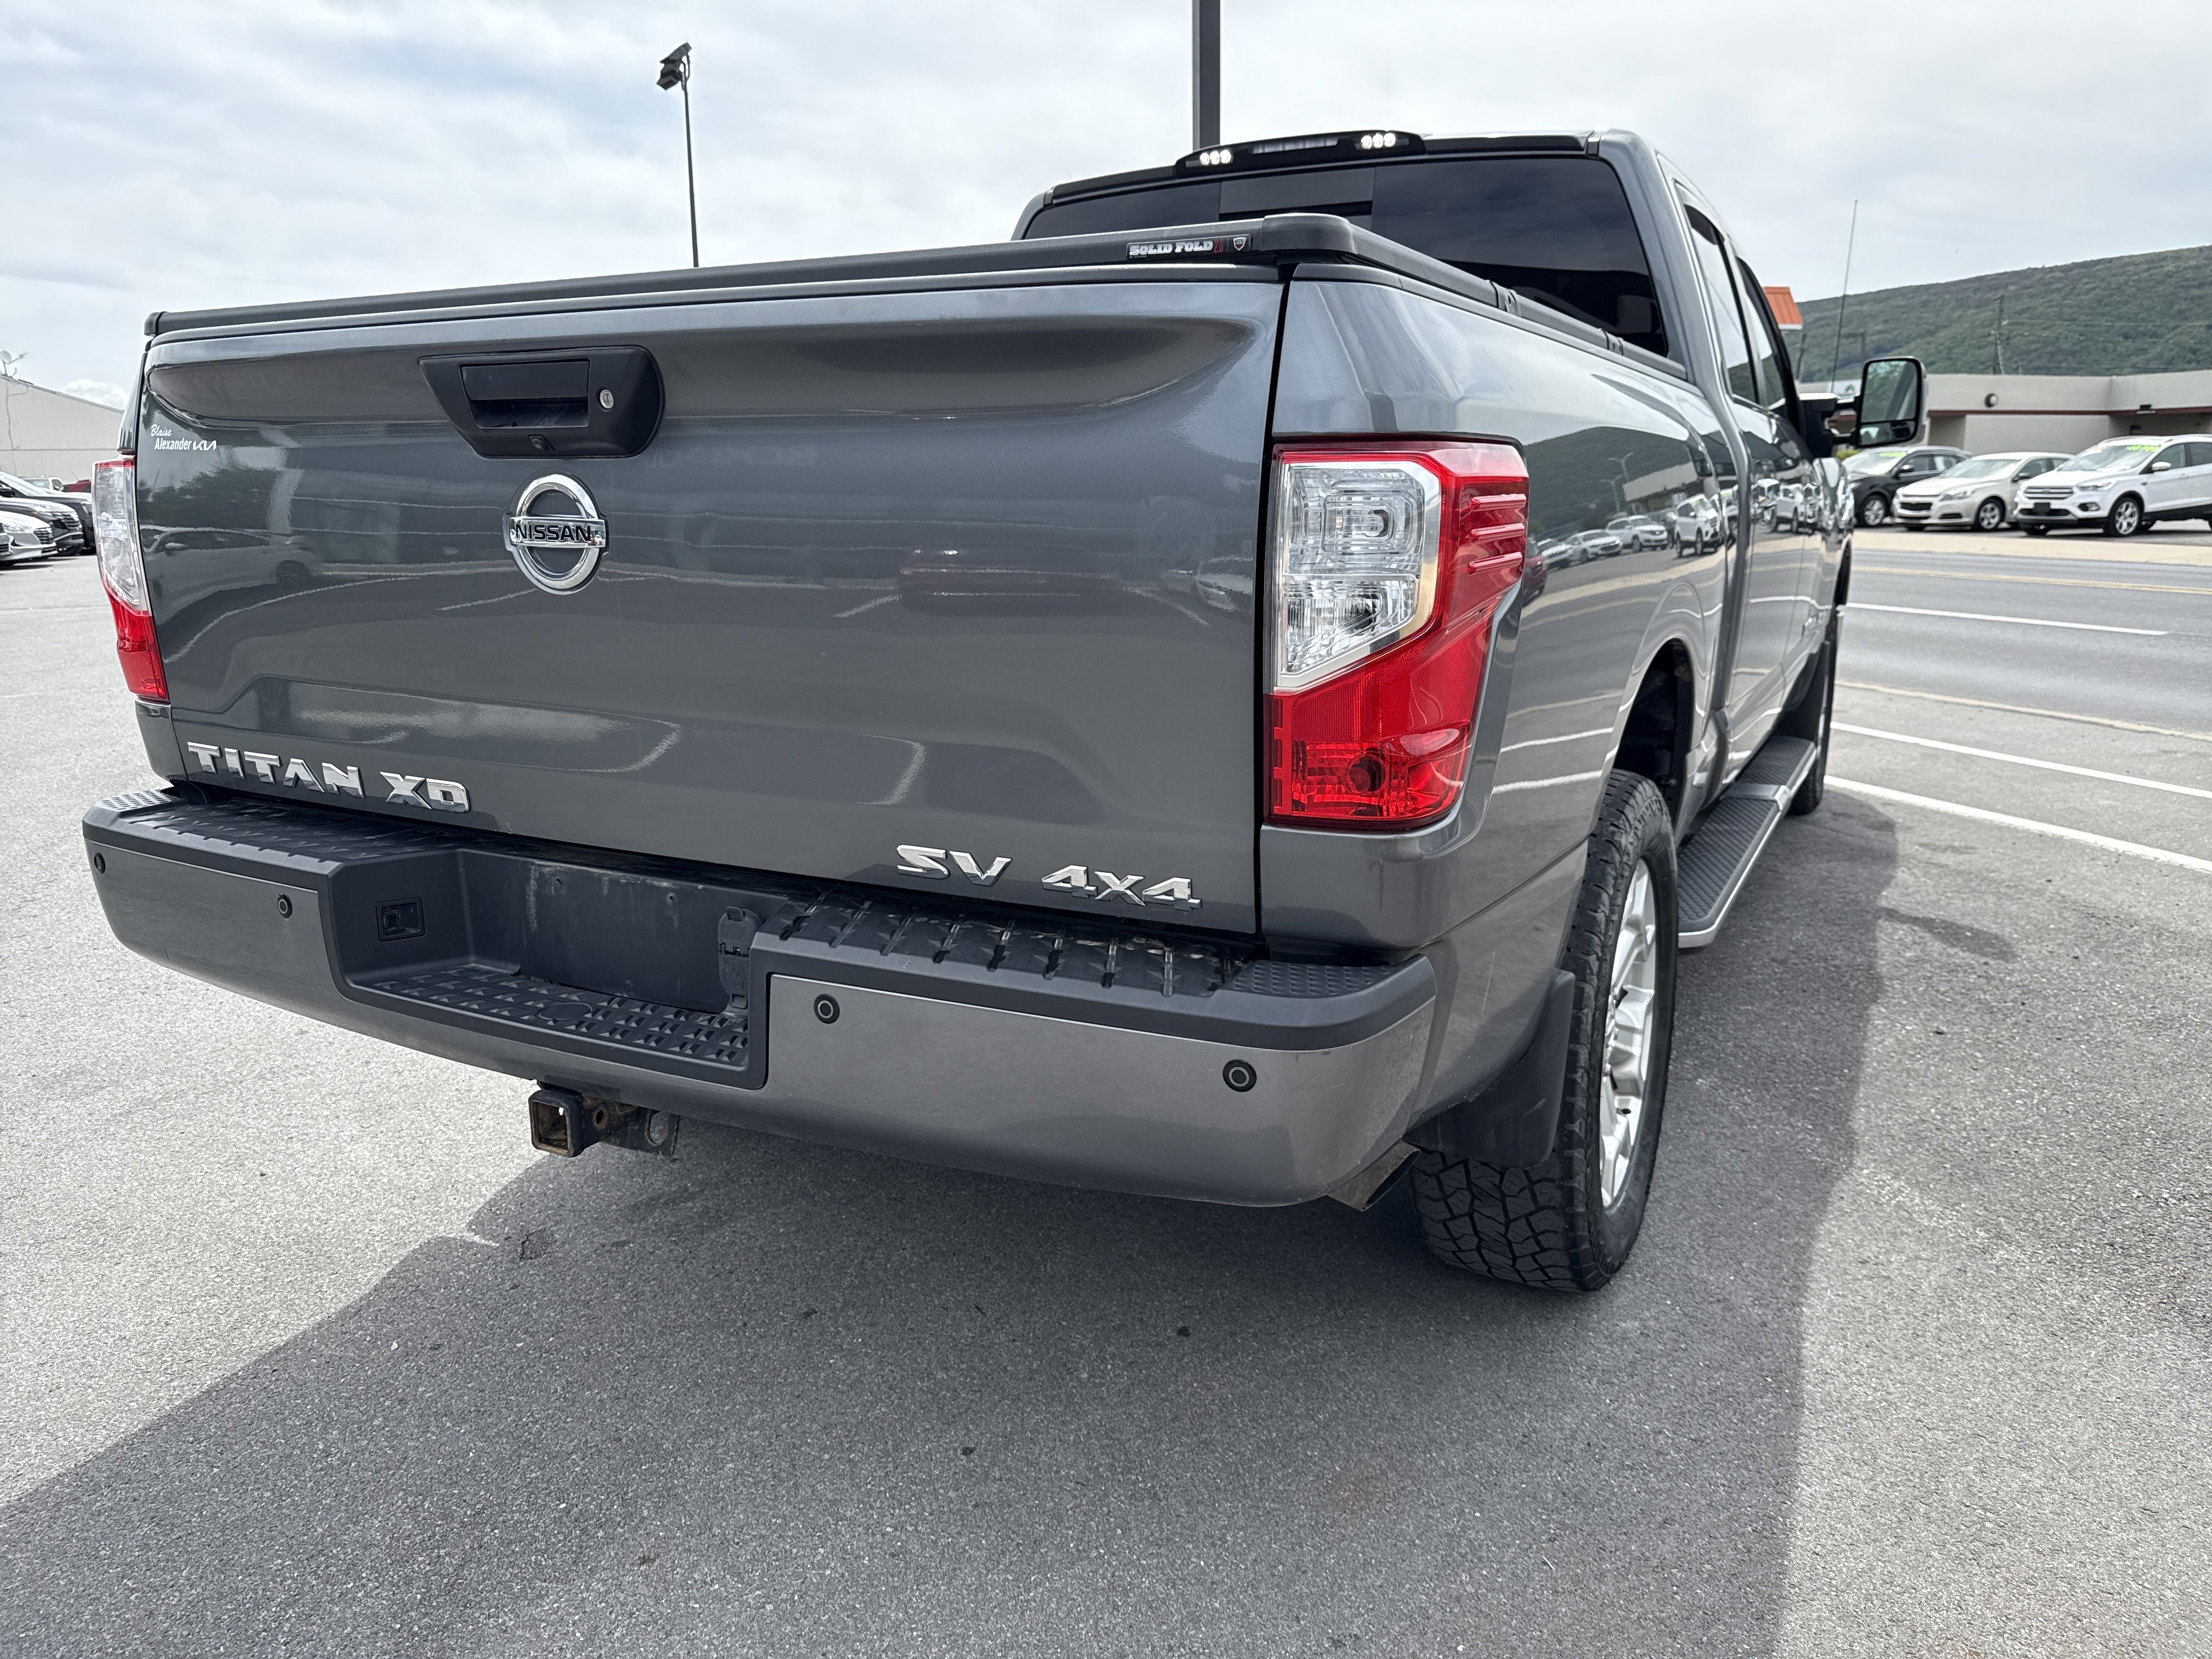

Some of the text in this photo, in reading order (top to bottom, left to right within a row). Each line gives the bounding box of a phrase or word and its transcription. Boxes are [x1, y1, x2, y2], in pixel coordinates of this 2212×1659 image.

[1129, 244, 1173, 255] SOLID
[1175, 240, 1213, 253] FOLD
[150, 424, 172, 437] Blaise
[154, 438, 217, 450] Alexander KIA
[515, 523, 591, 541] NISSAN
[187, 741, 471, 813] TITAN XD
[896, 844, 1013, 887] SV
